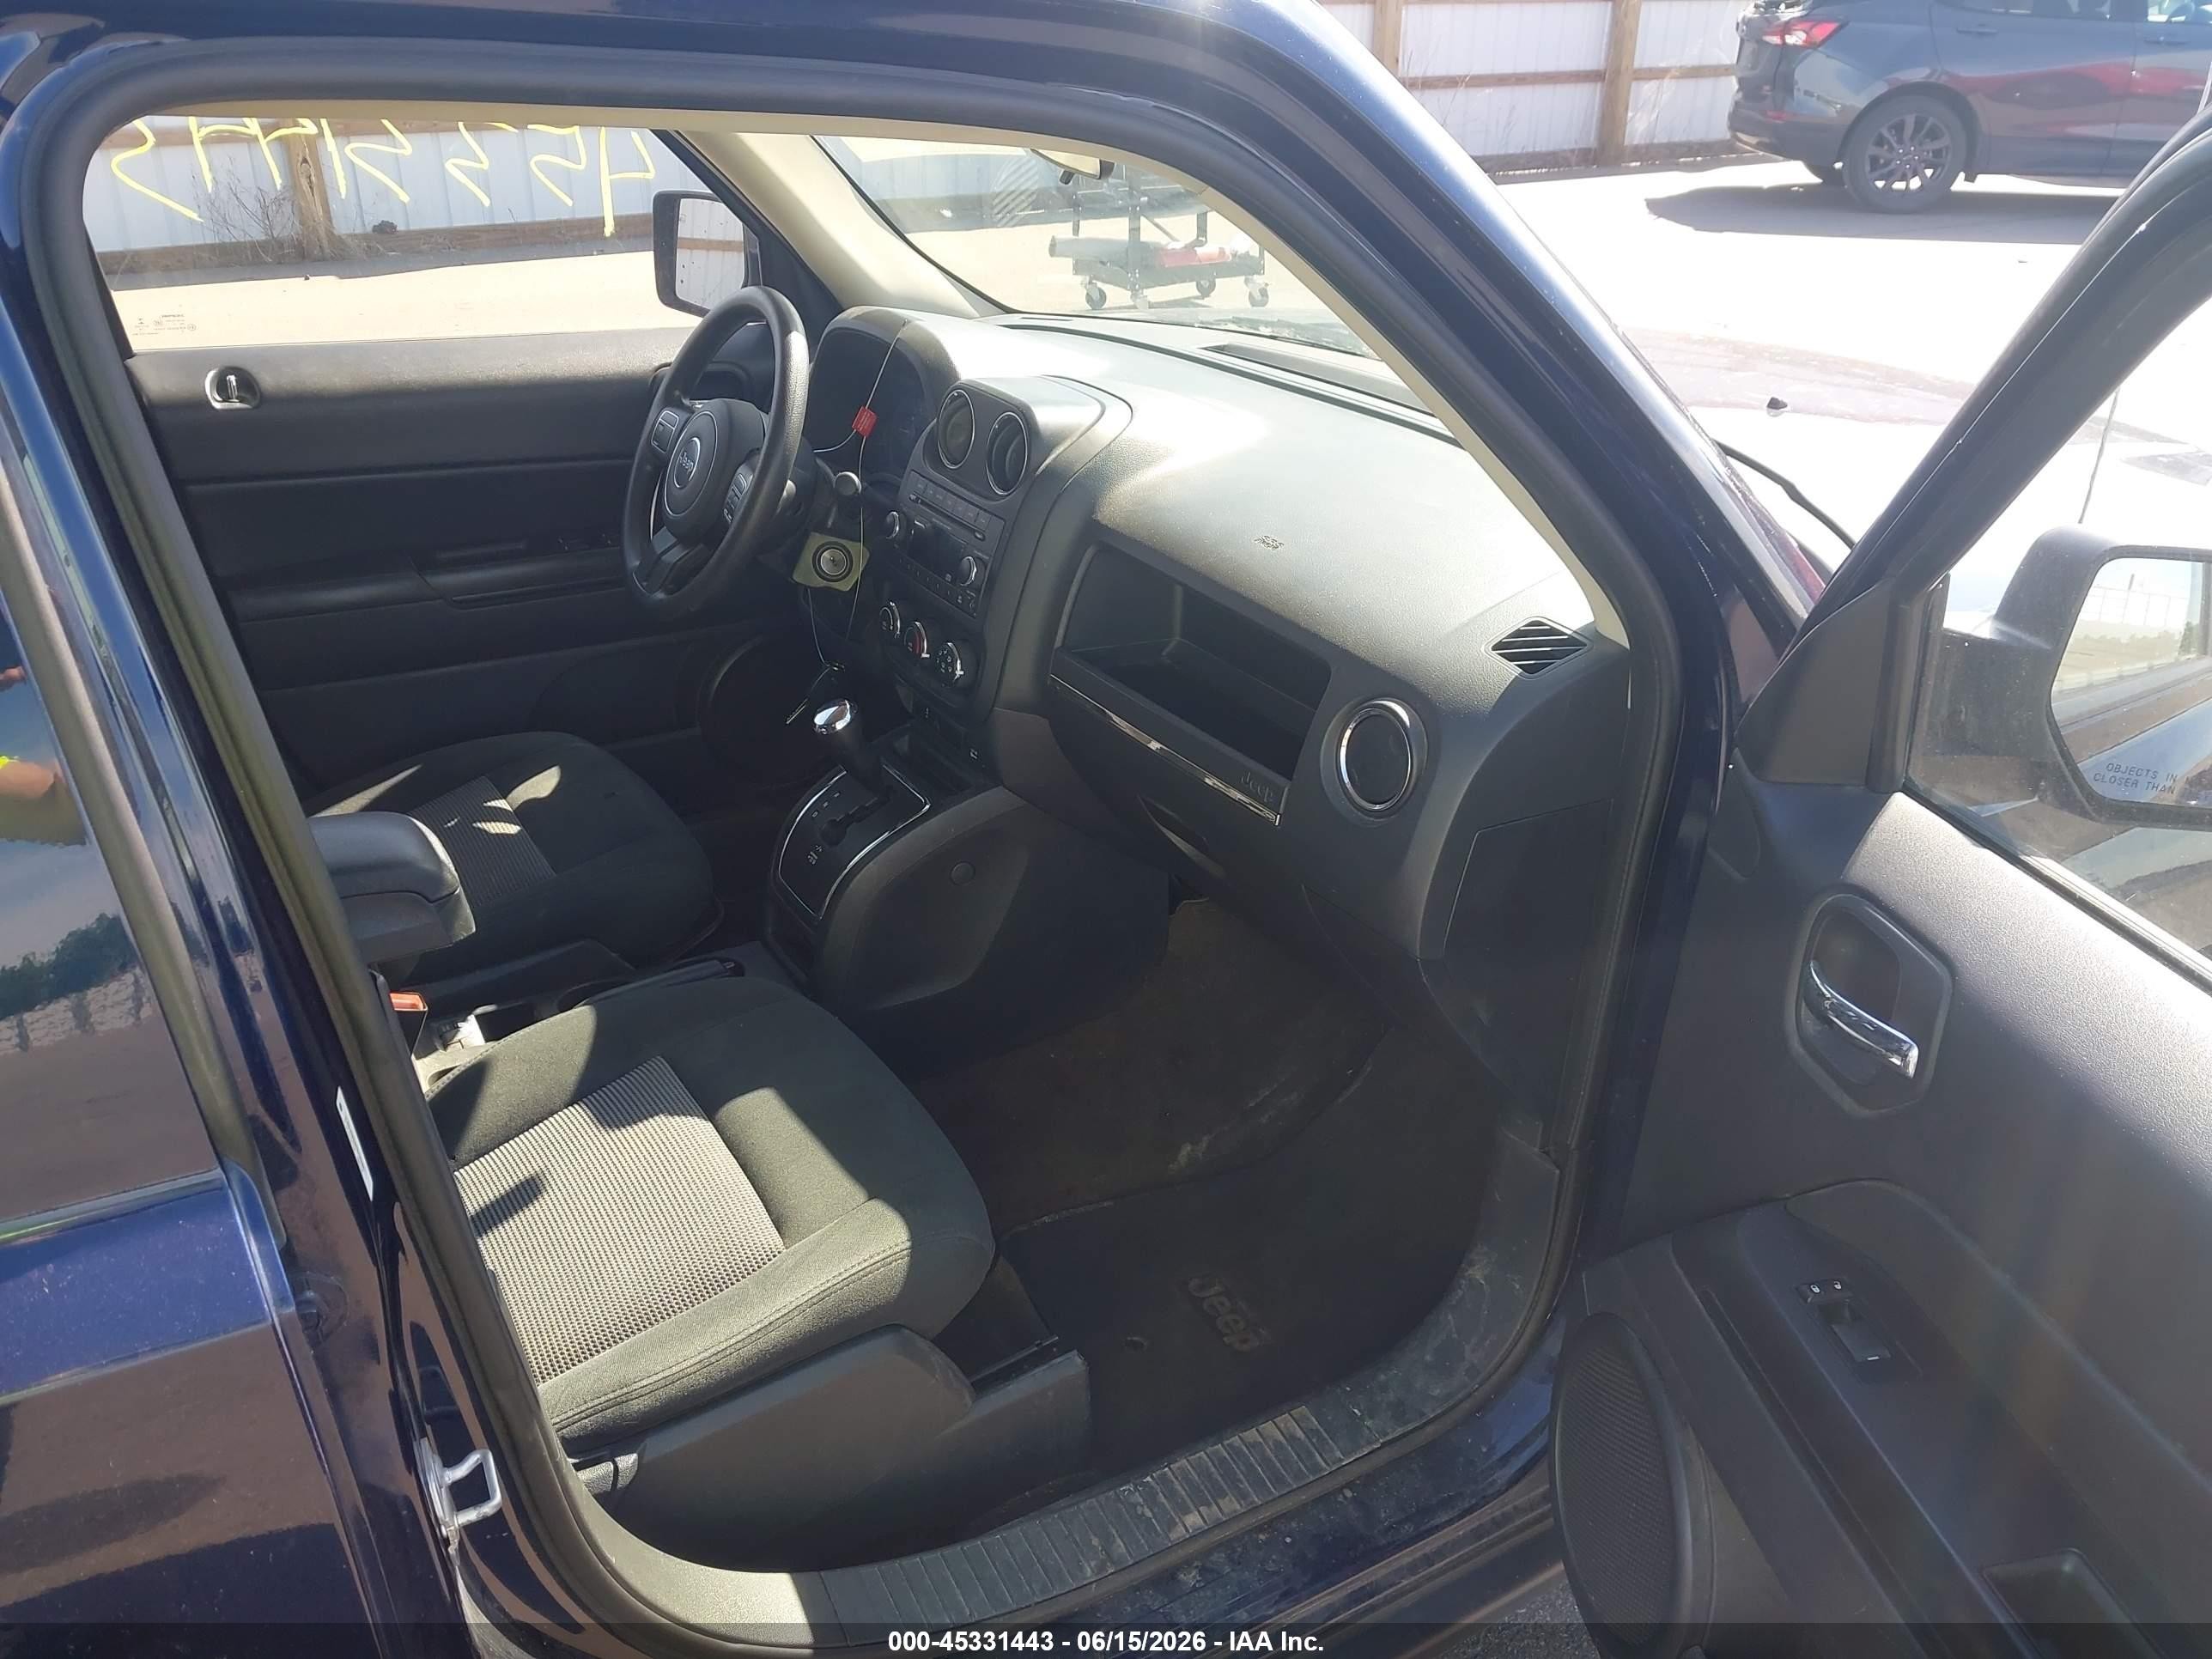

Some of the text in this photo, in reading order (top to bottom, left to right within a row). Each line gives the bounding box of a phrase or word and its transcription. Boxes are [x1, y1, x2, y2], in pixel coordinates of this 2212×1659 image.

[2093, 772, 2139, 788] CLOSER
[2145, 781, 2176, 794] THAN
[2106, 763, 2178, 783] OBJECTS IN
[1188, 1273, 1262, 1353] Jeep
